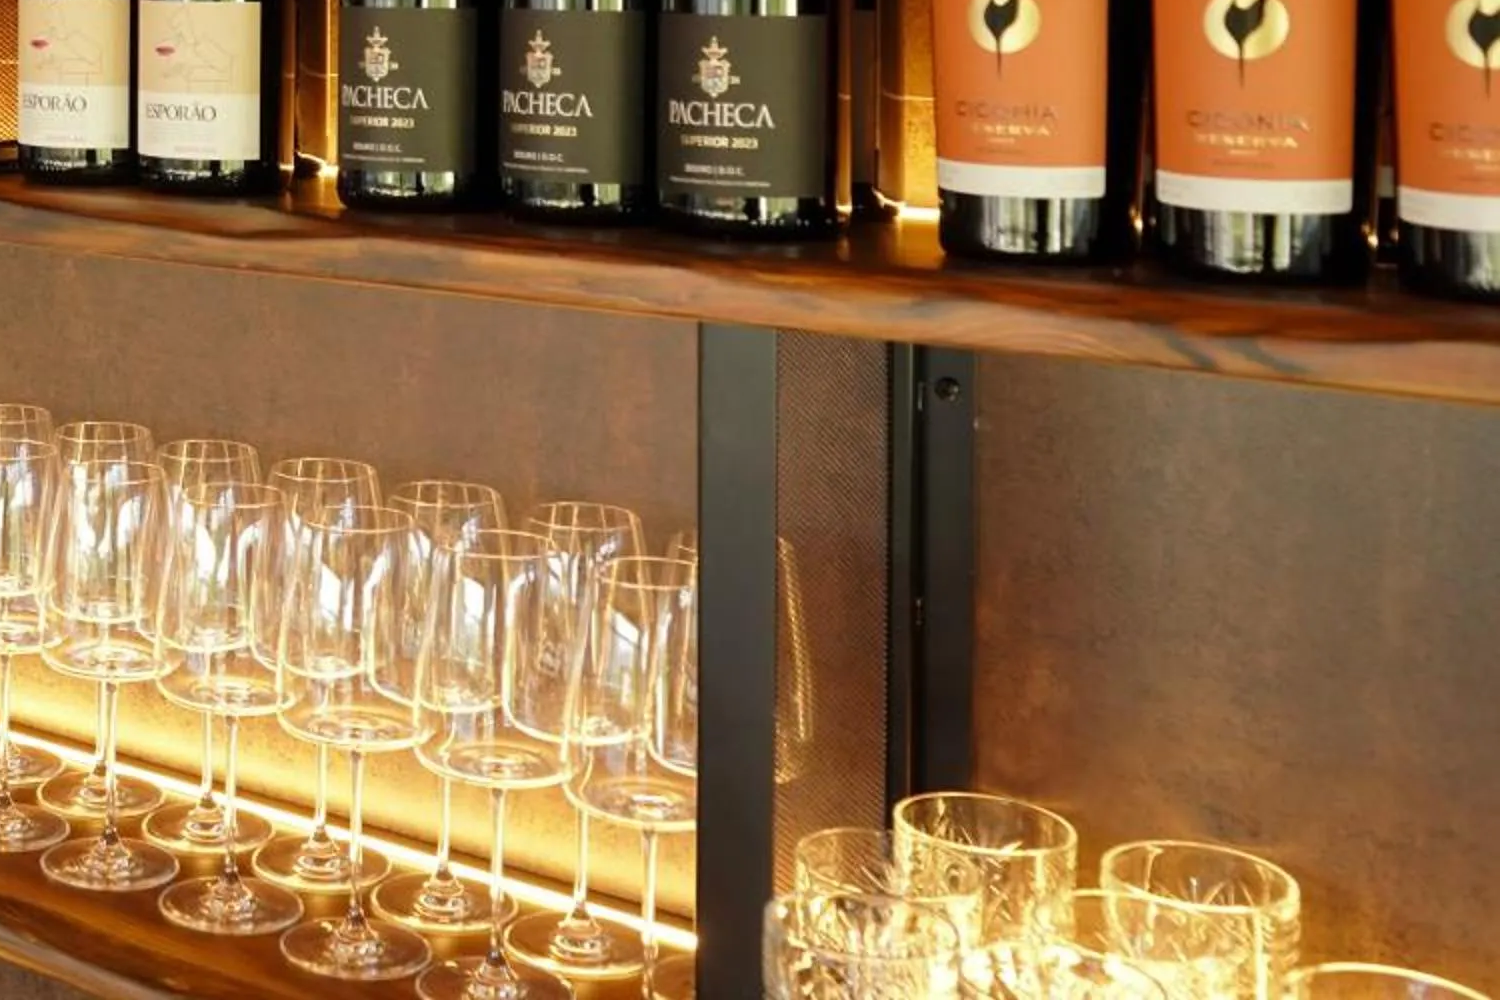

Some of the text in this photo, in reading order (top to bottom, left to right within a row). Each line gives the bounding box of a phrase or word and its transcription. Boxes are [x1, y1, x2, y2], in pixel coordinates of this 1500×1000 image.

[22, 92, 88, 113] ESPORÃO
[341, 85, 430, 110] PACHECA
[502, 90, 594, 118] PACHECA
[145, 99, 218, 122] ESPORÃO
[669, 100, 776, 129] PACHECA
